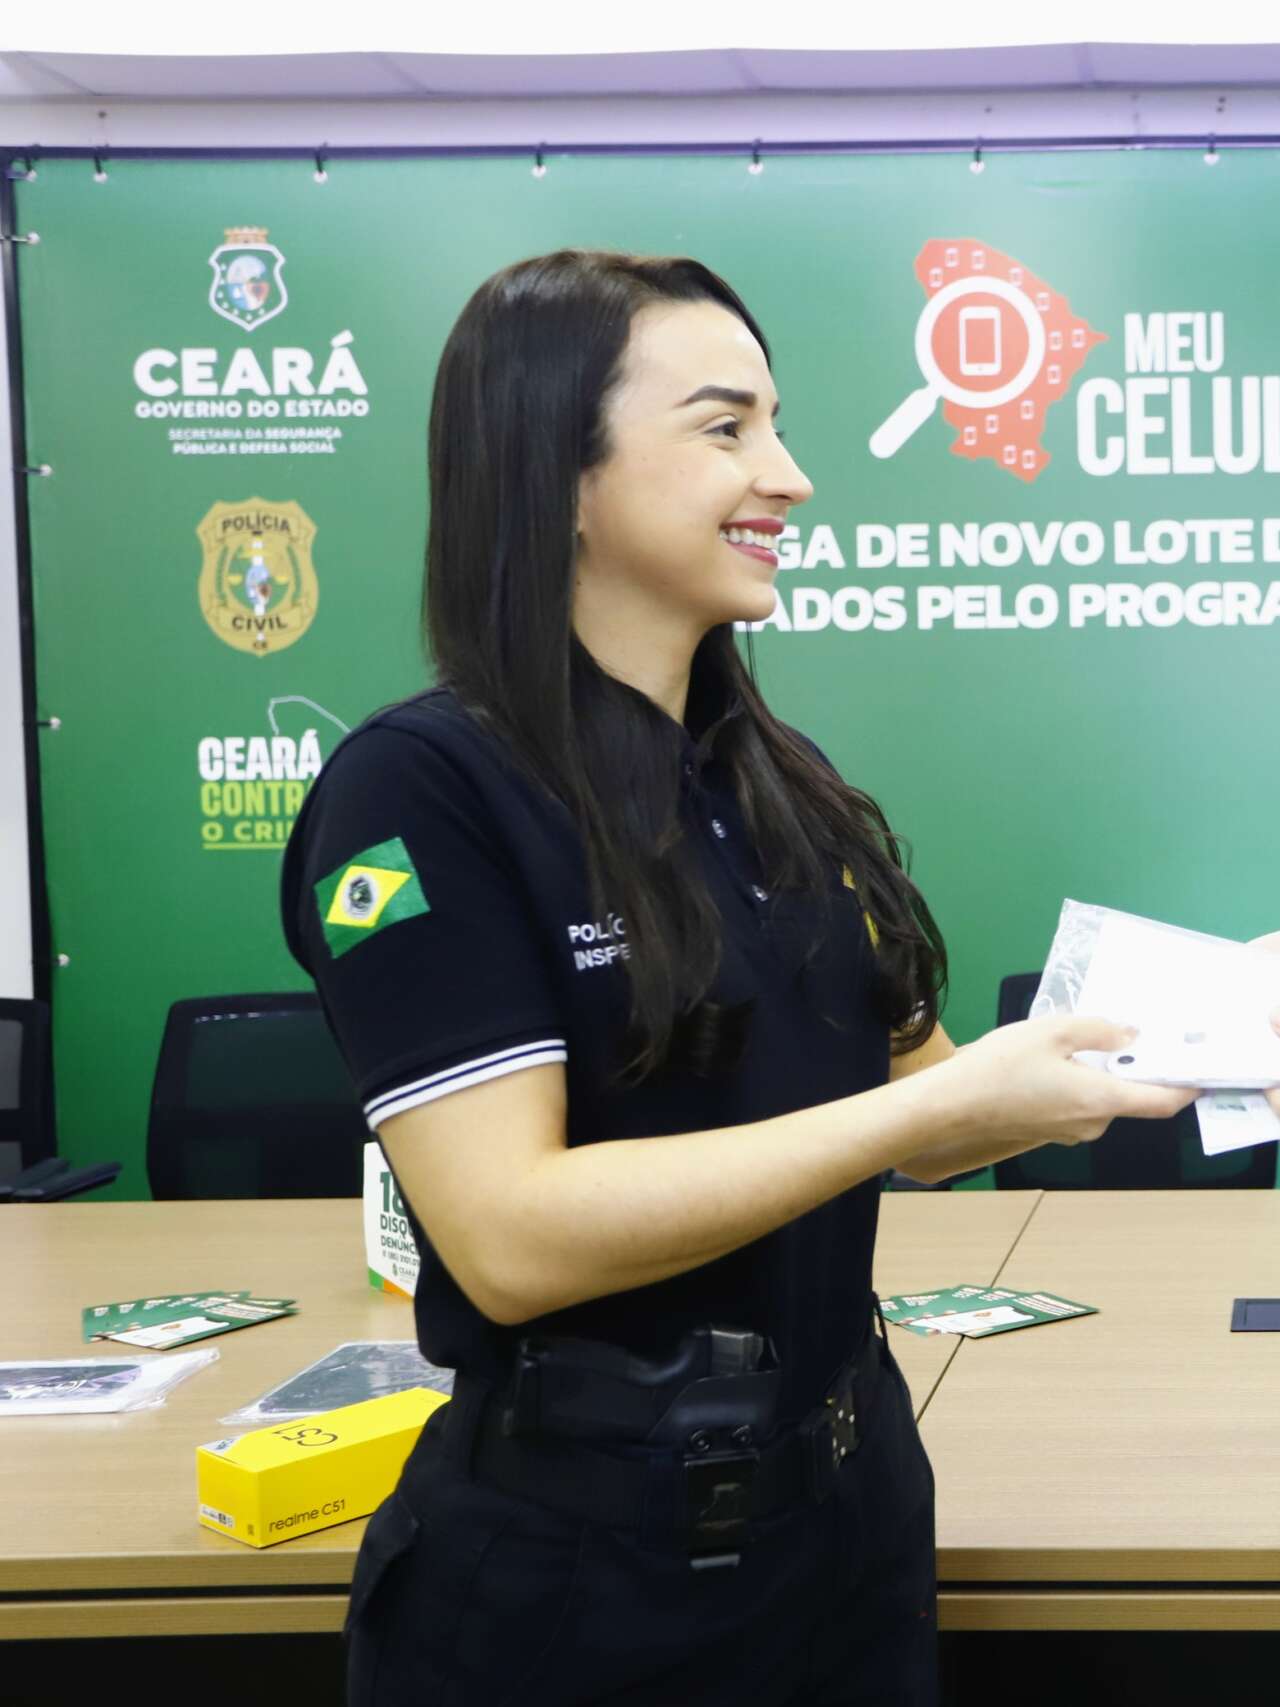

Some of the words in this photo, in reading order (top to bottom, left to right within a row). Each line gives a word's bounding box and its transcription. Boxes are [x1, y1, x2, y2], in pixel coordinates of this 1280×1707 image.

[1124, 311, 1224, 373] MEU
[133, 330, 368, 396] CEARÁ
[135, 401, 243, 418] GOVERNO
[247, 400, 279, 418] DO
[285, 399, 369, 417] ESTADO
[169, 428, 242, 440] SECRETARIA
[245, 428, 263, 440] DA
[264, 427, 342, 442] SEGURANÇA
[239, 442, 288, 454] DEFESA
[290, 442, 336, 454] SOCIAL
[222, 512, 290, 532] POLÍCIA
[856, 523, 930, 568] DE
[939, 521, 1105, 567] NOVO
[1113, 519, 1254, 565] LOTE
[734, 584, 907, 632] ADOS
[917, 584, 1059, 630] PELO
[232, 615, 287, 631] CIVIL
[198, 728, 322, 781] CEARÁ
[201, 781, 311, 817] CONTR
[201, 820, 224, 841] O
[233, 820, 294, 841] CRI
[380, 1214, 414, 1239] DISQ
[268, 1507, 319, 1533] realme
[321, 1499, 347, 1516] C51
